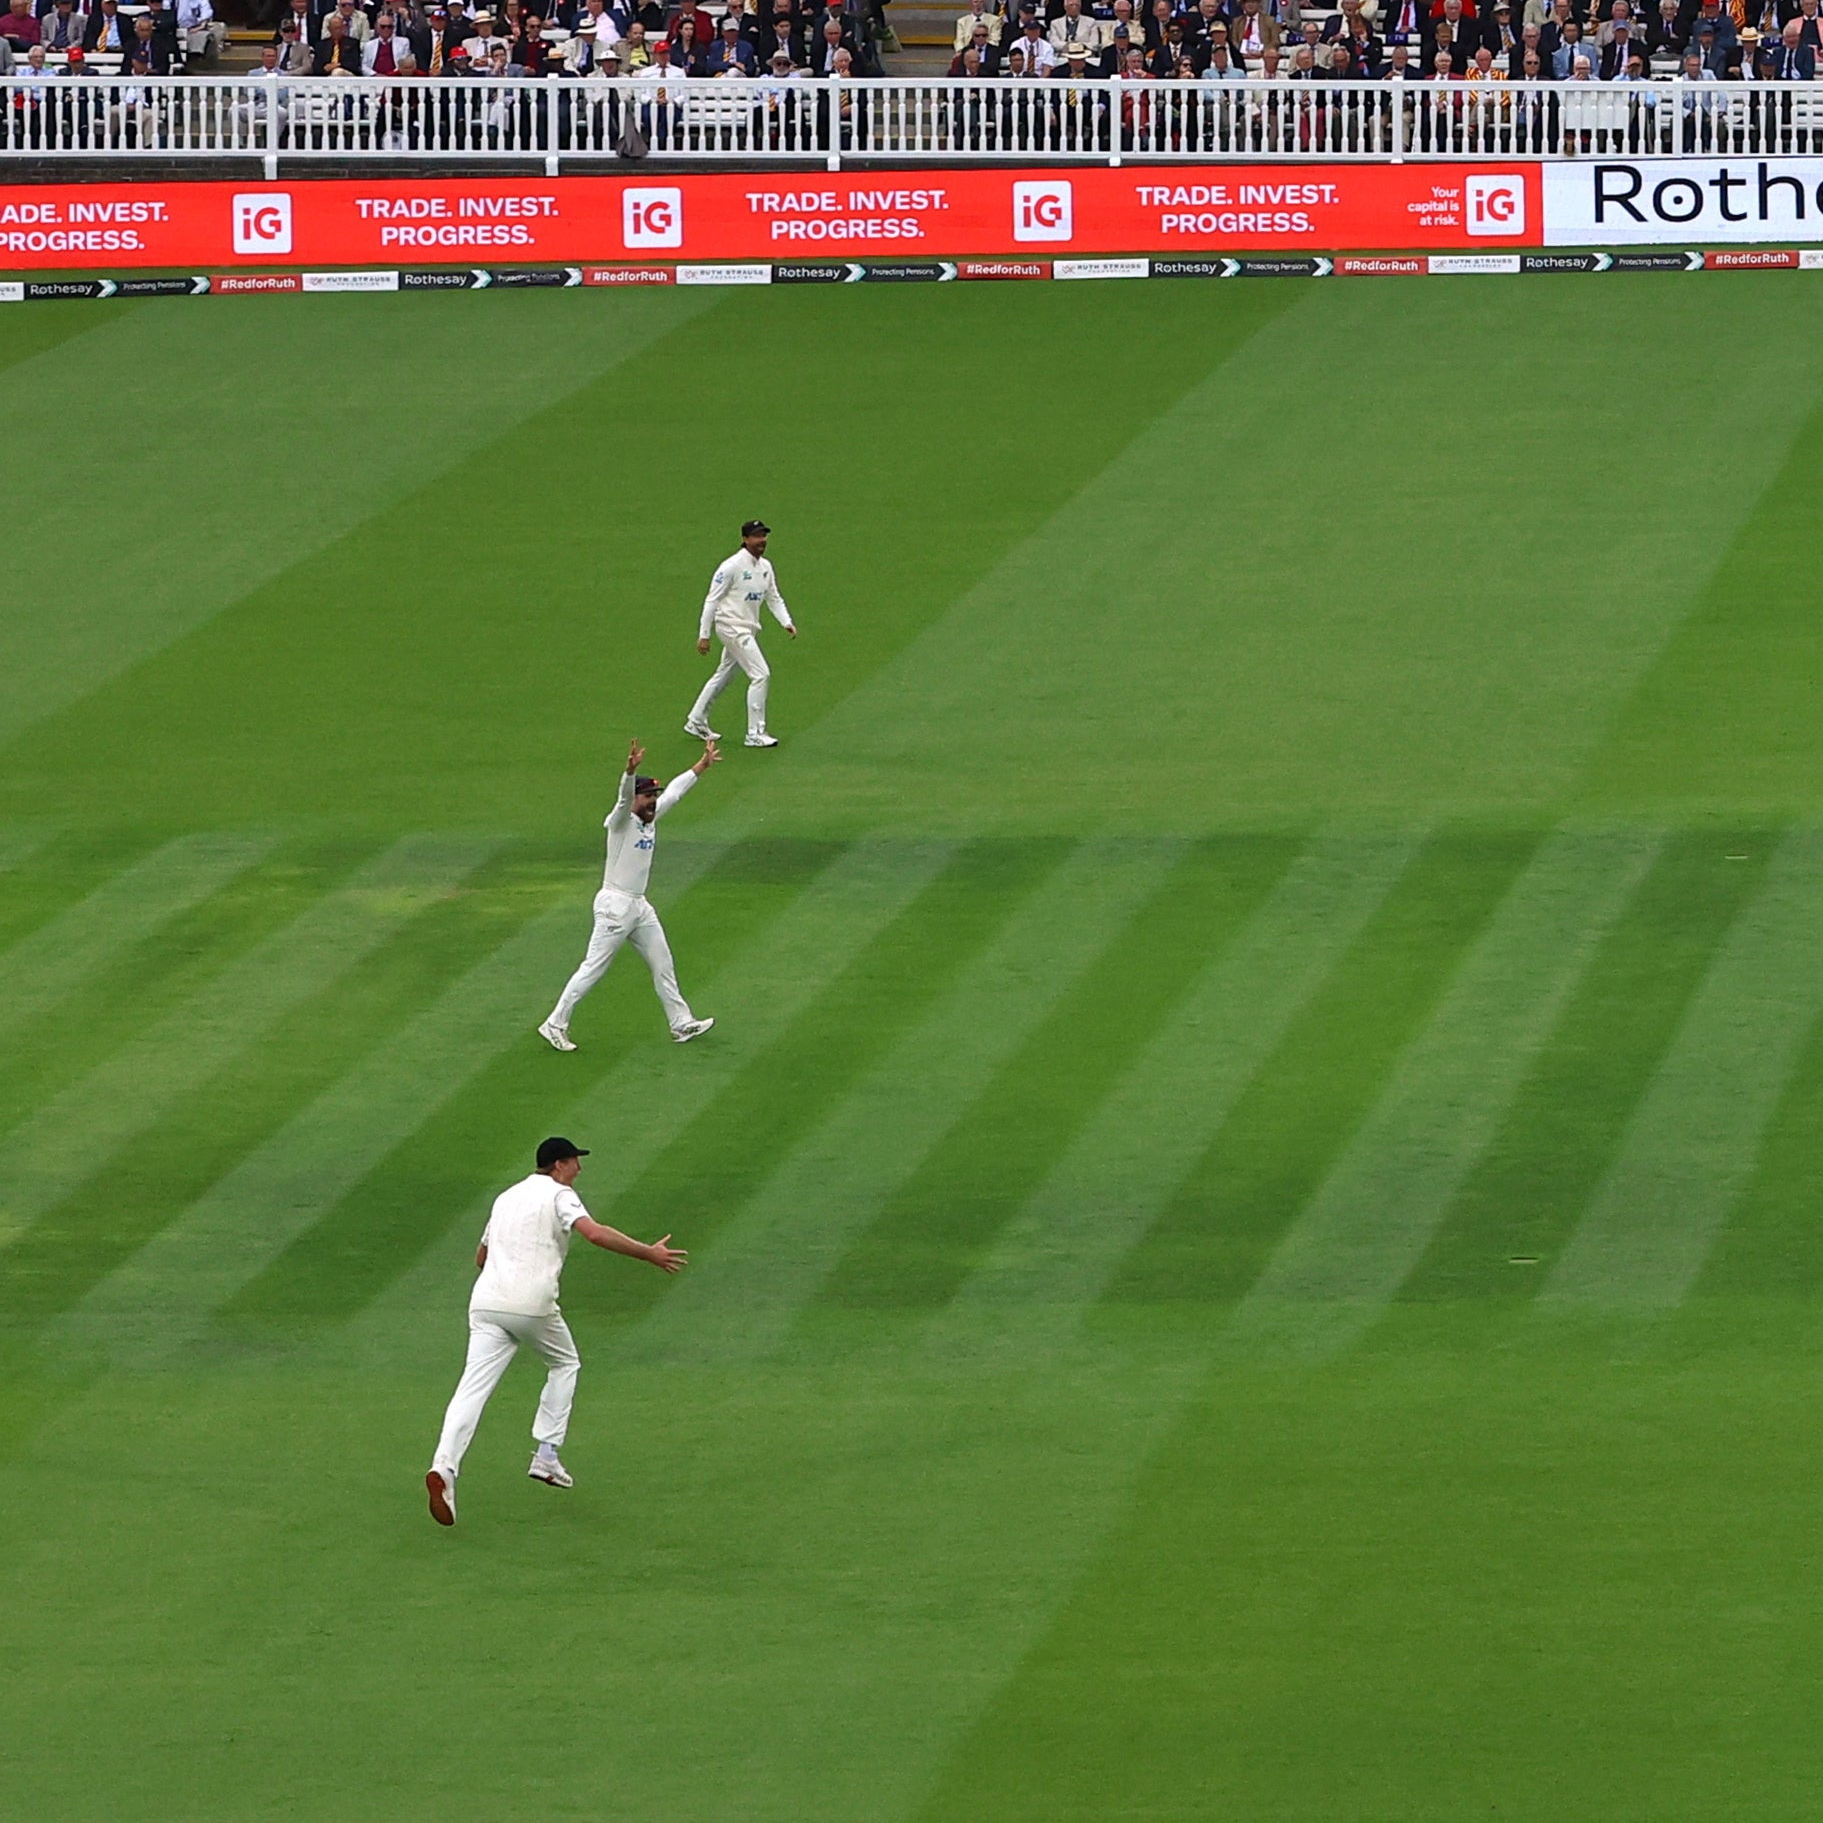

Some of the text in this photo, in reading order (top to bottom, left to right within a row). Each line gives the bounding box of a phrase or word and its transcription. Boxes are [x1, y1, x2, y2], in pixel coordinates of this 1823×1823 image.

[1135, 184, 1339, 206] TRADE. INVEST.
[1431, 186, 1459, 198] Your
[355, 196, 559, 219] TRADE. INVEST.
[745, 190, 949, 212] TRADE. INVEST.
[1407, 200, 1460, 214] capital is
[68, 202, 169, 223] INVEST.
[1161, 212, 1315, 233] PROGRESS.
[1419, 214, 1459, 226] at risk.
[381, 224, 535, 246] PROGRESS.
[771, 218, 925, 240] PROGRESS.
[1526, 257, 1588, 269] Rothesay
[1715, 252, 1790, 265] #RedforRuth
[966, 263, 1041, 275] #RedforRuth
[1154, 262, 1217, 275] Rothesay
[1344, 260, 1419, 271] #RedforRuth
[593, 271, 668, 282] #RedforRuth
[778, 267, 841, 280] Rothesay
[221, 277, 296, 289] #RedforRuth
[404, 274, 467, 287] Rothesay
[30, 284, 93, 295] Rothesay
